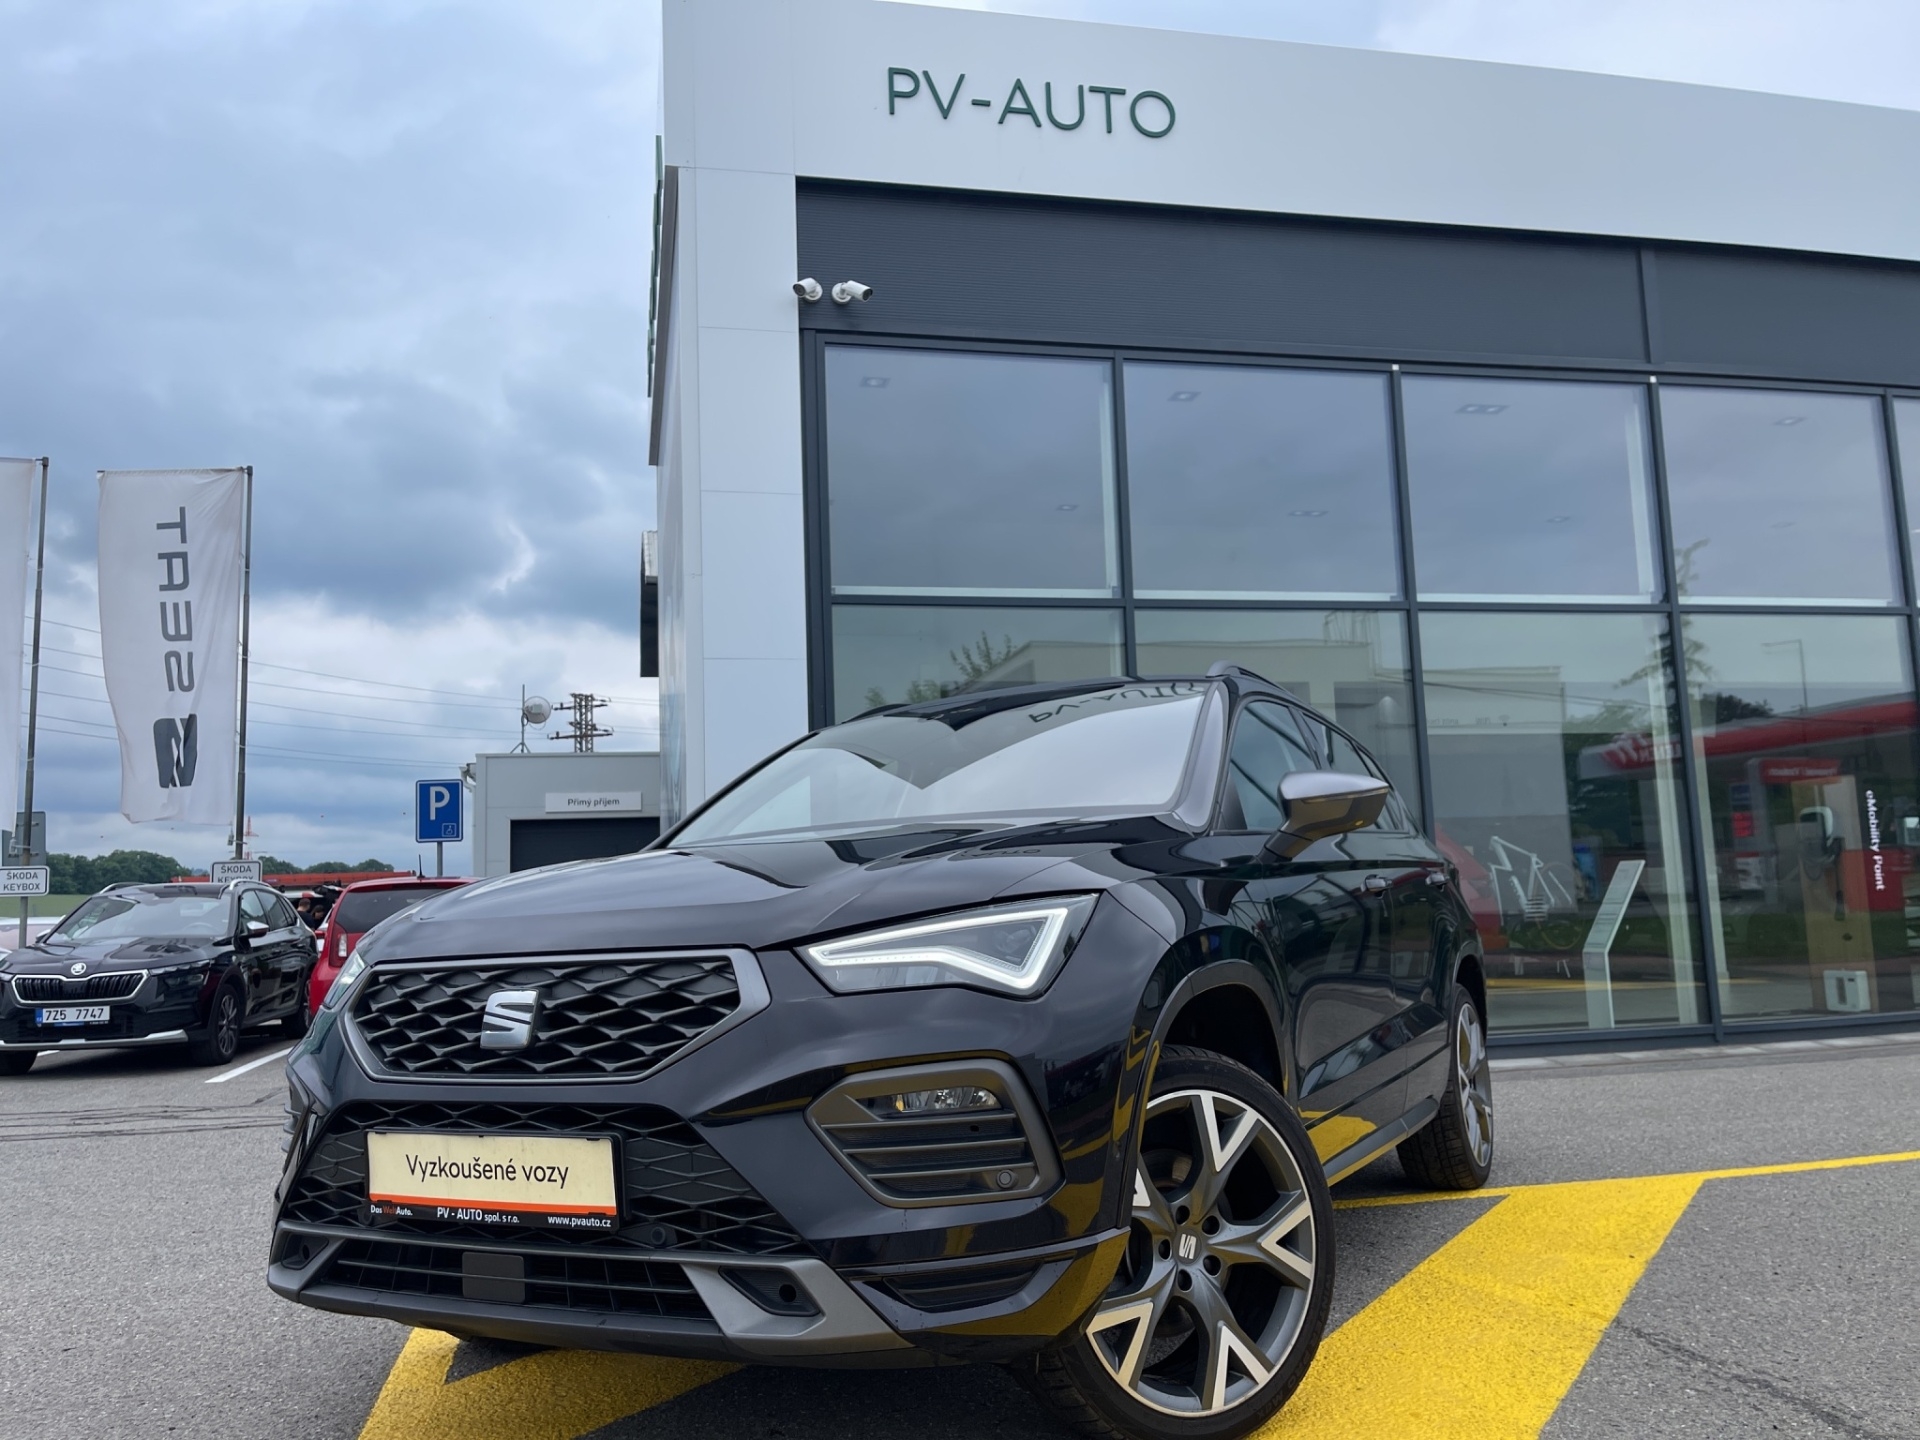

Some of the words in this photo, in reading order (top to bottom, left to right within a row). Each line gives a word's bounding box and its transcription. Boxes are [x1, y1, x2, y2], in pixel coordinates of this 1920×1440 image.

[888, 66, 1176, 139] PV-AUTO
[429, 786, 450, 821] P
[567, 797, 592, 808] Přímý
[594, 797, 620, 808] příjem
[1865, 789, 1881, 852] eMobility
[220, 864, 252, 874] ŠKODA
[1872, 855, 1886, 890] Point
[6, 871, 39, 881] ŠKODA
[3, 882, 41, 892] KEYBOX
[45, 1009, 67, 1021] 7Z5
[75, 1008, 104, 1020] 7747
[405, 1154, 517, 1183] Vyzkoušené
[521, 1165, 569, 1189] vozy
[370, 1204, 382, 1213] Das
[437, 1207, 450, 1219] PV
[456, 1209, 483, 1221] AUTO
[484, 1211, 501, 1223] spol.
[547, 1215, 612, 1228] www.pvauto.cz
